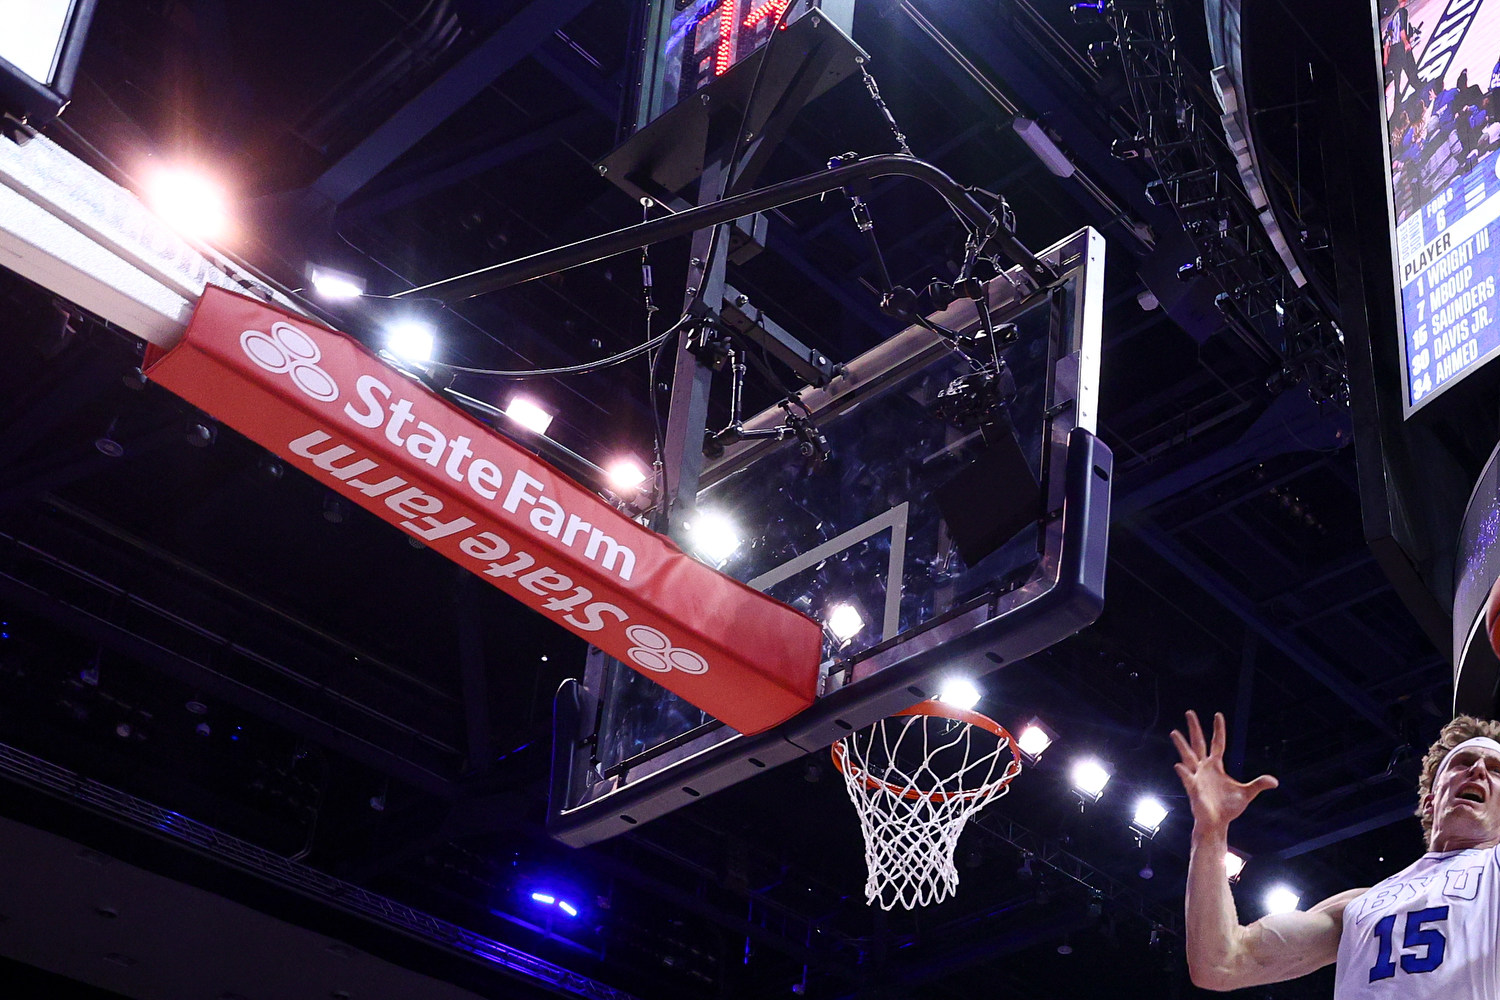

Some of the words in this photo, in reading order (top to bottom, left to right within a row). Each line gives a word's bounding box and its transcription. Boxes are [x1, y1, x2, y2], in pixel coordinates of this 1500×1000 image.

[1404, 232, 1451, 281] PLAYER
[1417, 277, 1424, 297] 1
[1427, 238, 1474, 289] WRIGHT
[1476, 227, 1490, 255] III
[1417, 300, 1425, 323] 7
[1430, 265, 1473, 313] MBOUP
[1432, 275, 1495, 336] SAUNDERS
[1433, 318, 1470, 360] DAVIS
[1471, 306, 1493, 334] JR.
[1436, 338, 1478, 385] AHMED
[1356, 866, 1484, 925] BYU
[1369, 905, 1449, 984] 15
